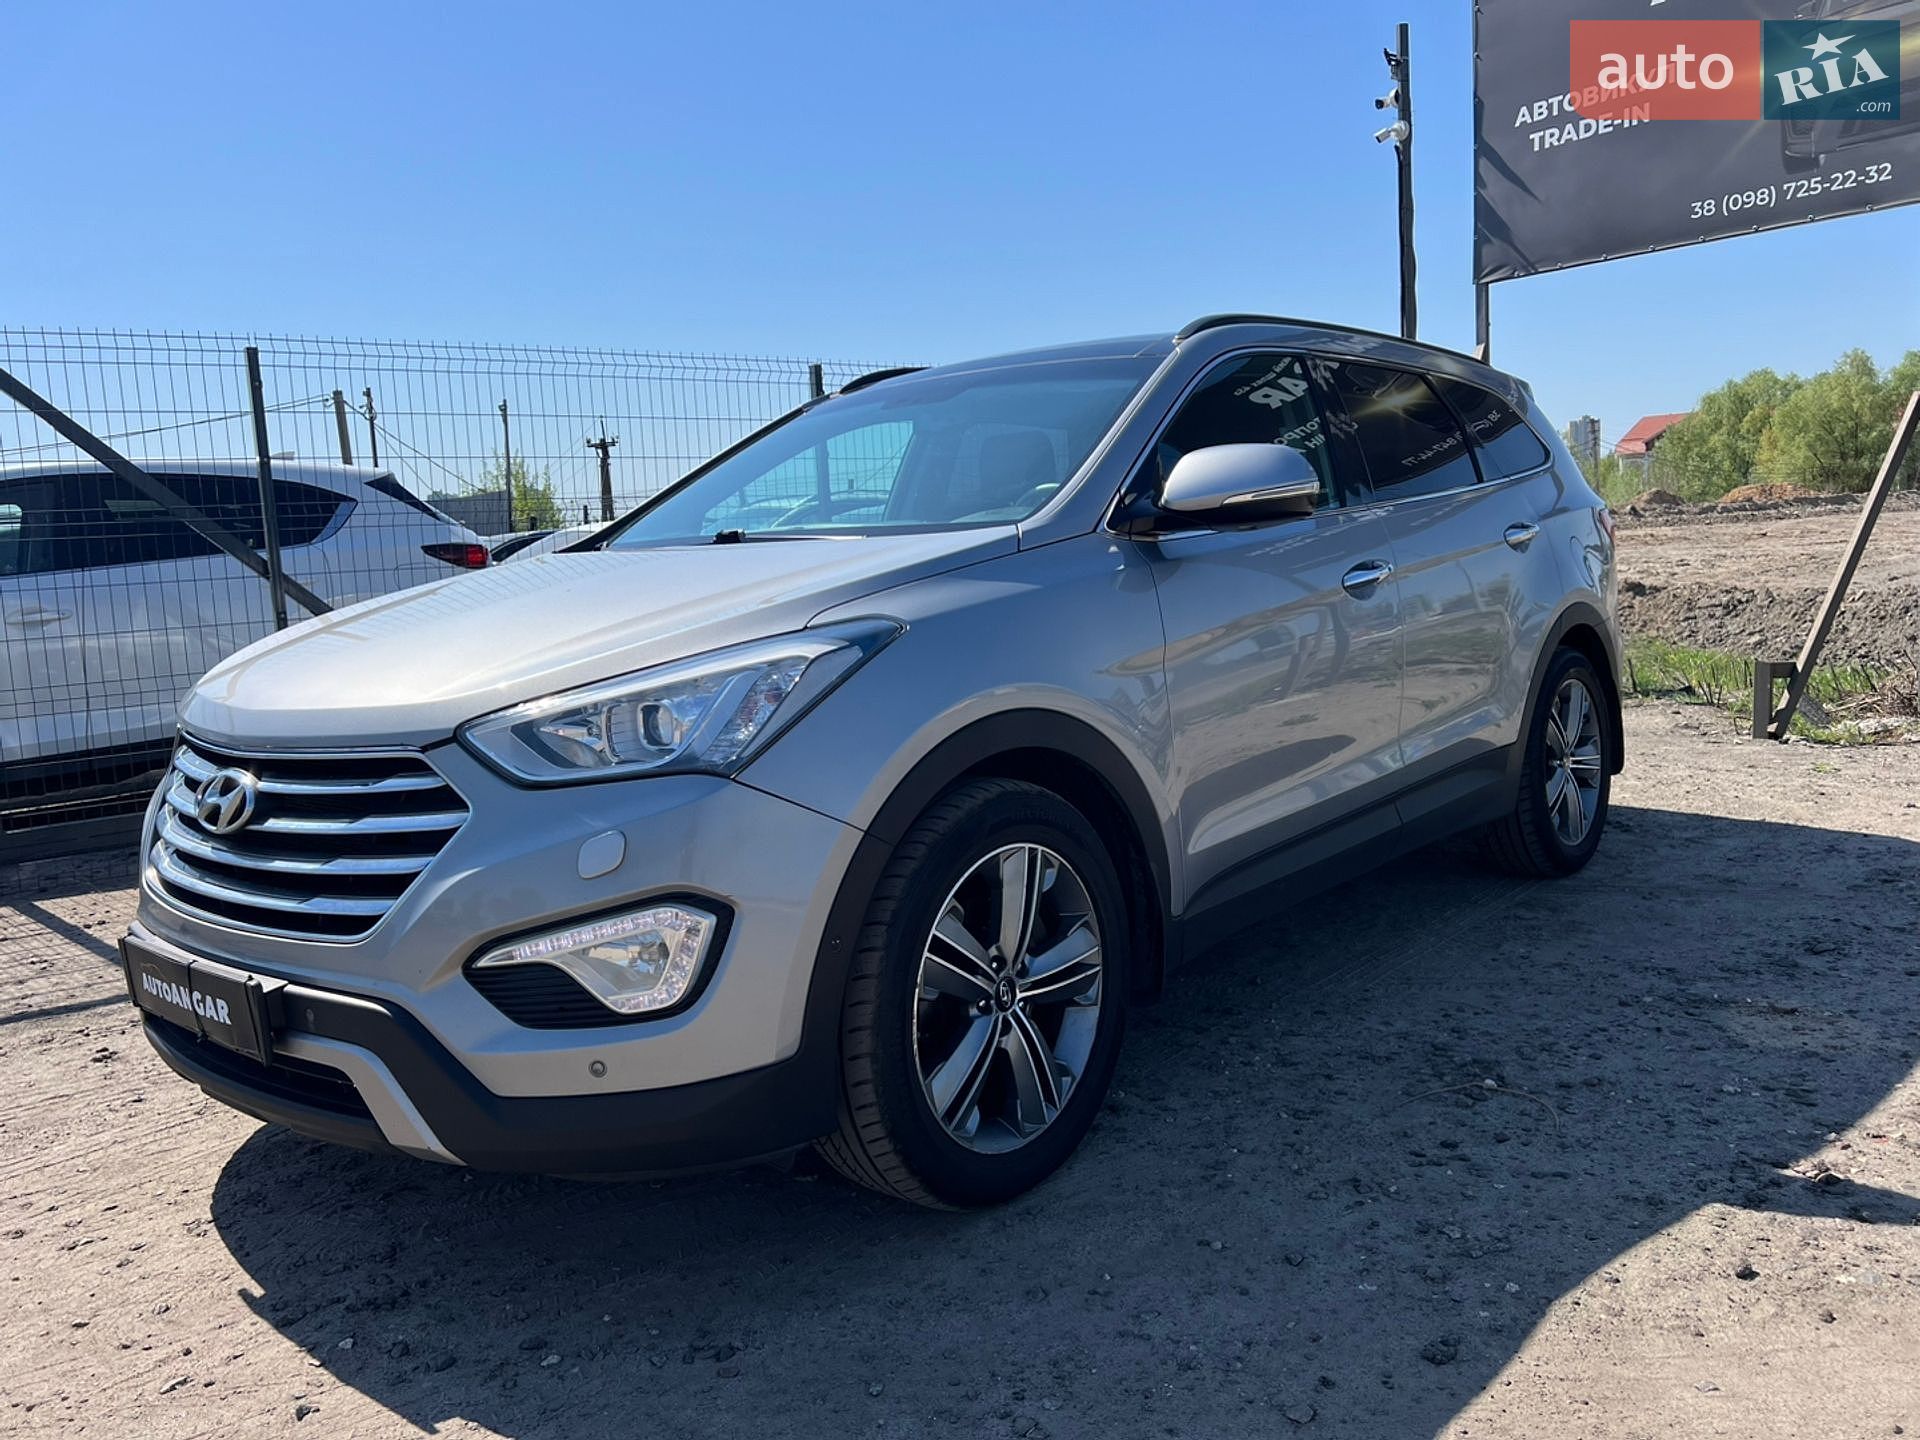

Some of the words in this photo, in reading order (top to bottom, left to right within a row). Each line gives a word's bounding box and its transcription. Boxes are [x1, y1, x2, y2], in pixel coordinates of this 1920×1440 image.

[1529, 102, 1651, 152] TRADE-IN
[1690, 199, 1716, 219] 38
[1722, 185, 1776, 216] (098)
[1783, 162, 1893, 200] 725-22-32
[142, 972, 232, 1026] AUTOANGAR
